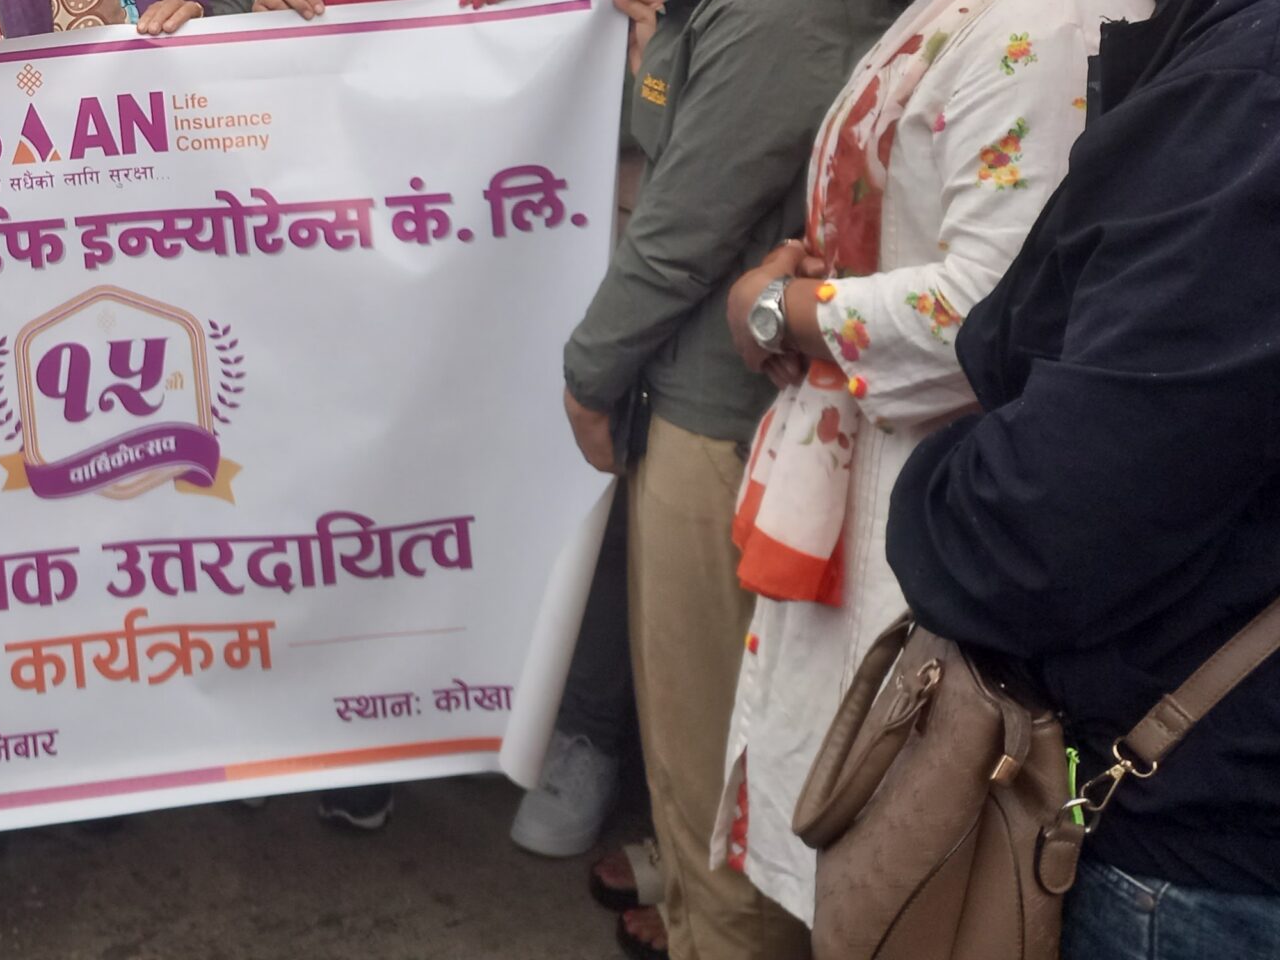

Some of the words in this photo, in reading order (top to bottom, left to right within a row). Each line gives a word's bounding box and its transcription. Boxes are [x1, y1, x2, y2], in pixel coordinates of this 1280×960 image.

[172, 93, 208, 110] Life
[174, 112, 272, 131] Insurance
[176, 134, 269, 153] Company
[64, 166, 101, 187] लागि
[75, 188, 376, 271] इन्स्योरेन्स
[483, 164, 590, 239] लि.
[102, 510, 475, 597] उत्तरदायित्व
[4, 607, 276, 695] कार्यक्रम
